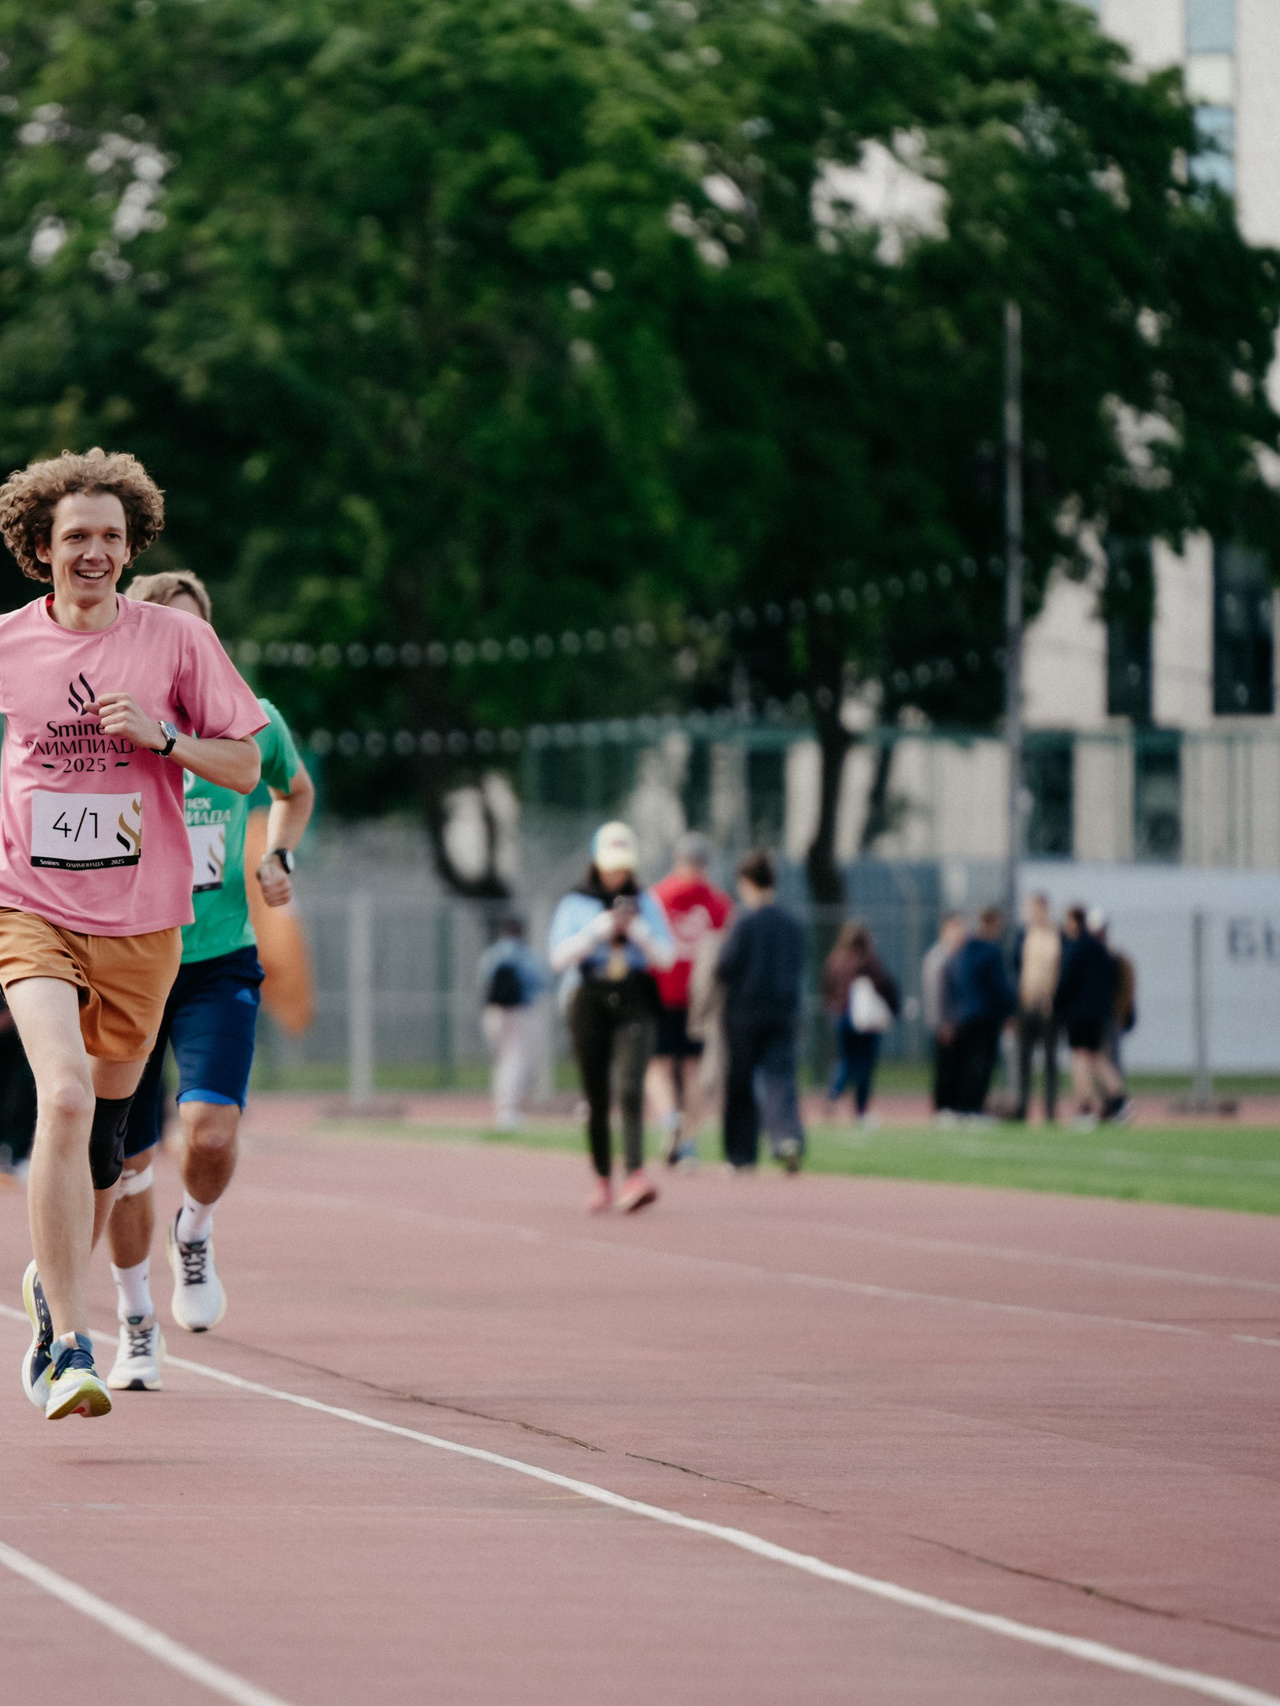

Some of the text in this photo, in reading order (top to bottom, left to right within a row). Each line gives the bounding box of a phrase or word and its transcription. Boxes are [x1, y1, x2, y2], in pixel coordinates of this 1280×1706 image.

[46, 720, 107, 738] Smine
[62, 758, 107, 773] 2025
[52, 807, 98, 842] 4/1
